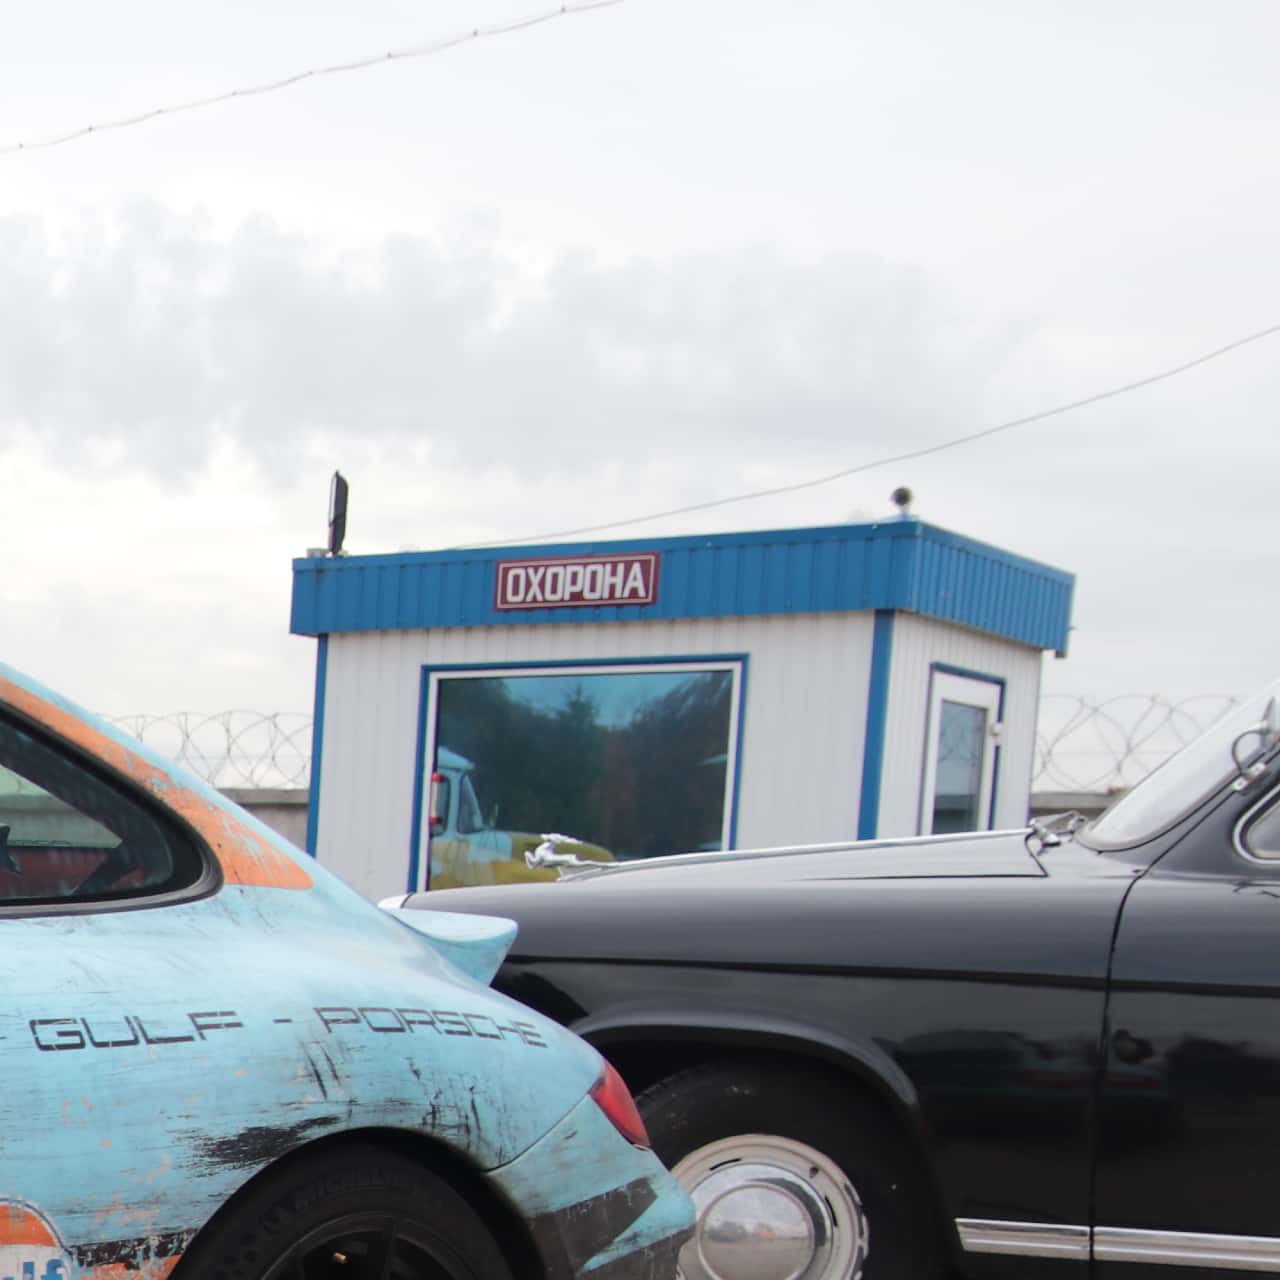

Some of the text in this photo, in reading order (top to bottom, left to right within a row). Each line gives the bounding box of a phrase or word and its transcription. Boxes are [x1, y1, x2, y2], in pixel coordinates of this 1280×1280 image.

[506, 561, 647, 603] ОХОРОНА
[28, 1010, 243, 1052] GULF
[314, 1006, 549, 1049] PORSCHE
